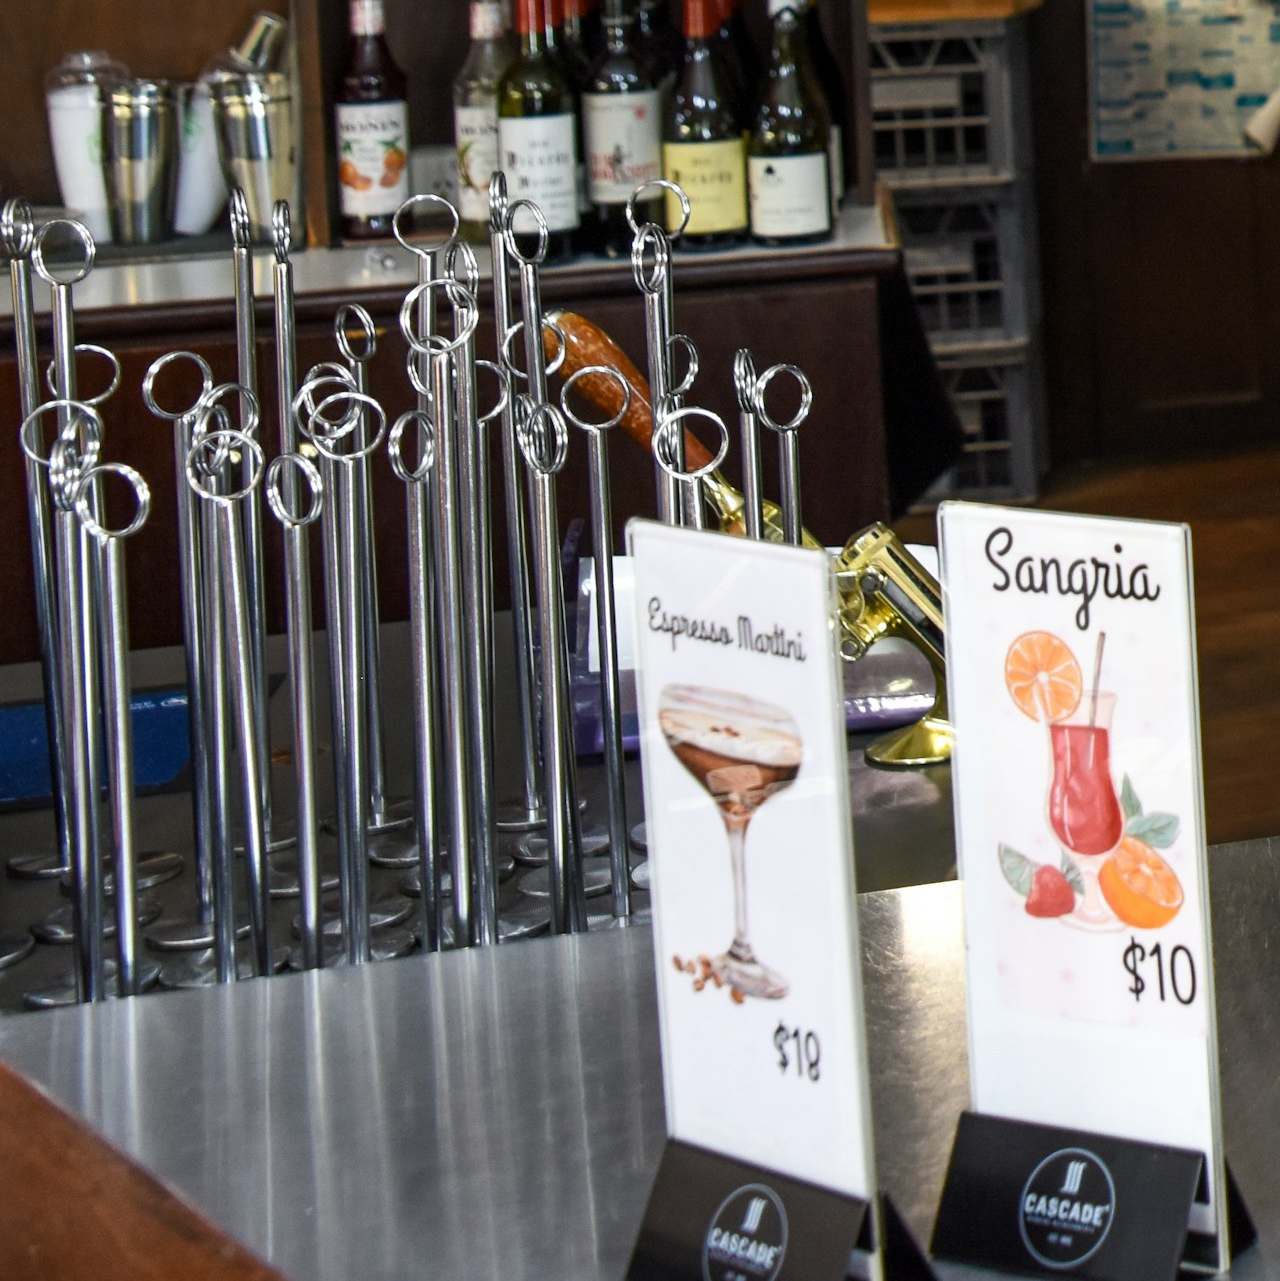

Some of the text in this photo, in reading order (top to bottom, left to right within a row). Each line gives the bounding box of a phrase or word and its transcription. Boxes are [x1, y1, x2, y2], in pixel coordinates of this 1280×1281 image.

[984, 527, 1161, 632] Sangria
[648, 596, 807, 663] Espresso Martini
[1122, 935, 1198, 1005] $10
[774, 1019, 821, 1082] $18
[1024, 1193, 1104, 1227] CASCADE
[709, 1227, 776, 1268] CASCADE
